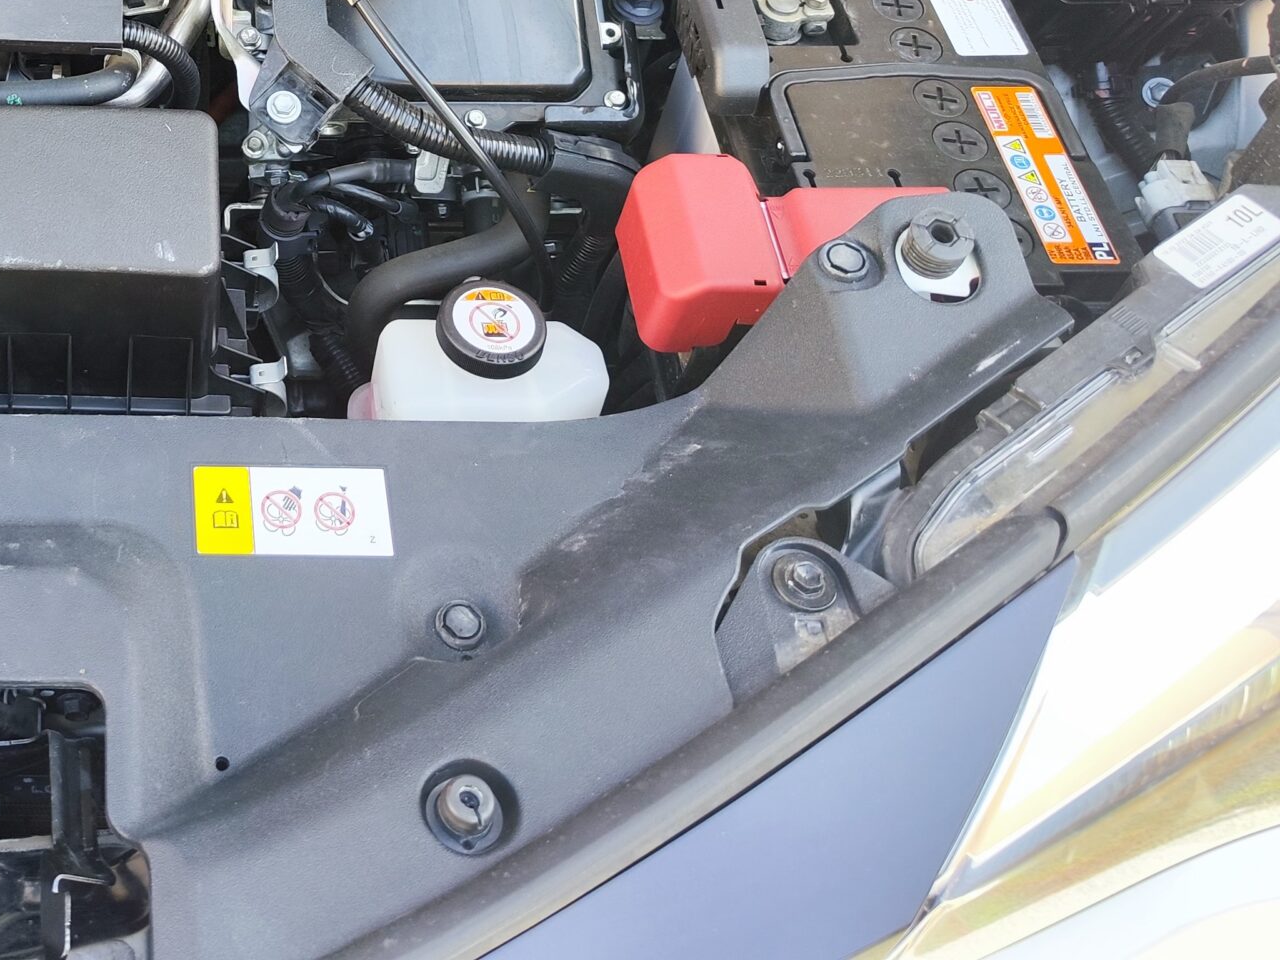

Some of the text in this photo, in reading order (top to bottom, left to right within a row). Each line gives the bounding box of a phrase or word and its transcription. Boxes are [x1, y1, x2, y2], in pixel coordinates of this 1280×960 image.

[977, 92, 1007, 130] MUTLU
[1061, 162, 1082, 195] CENTRAL
[1058, 178, 1087, 223] BATTERY
[1225, 204, 1265, 229] 10L
[1090, 243, 1115, 260] PL
[475, 349, 524, 363] DENSO
